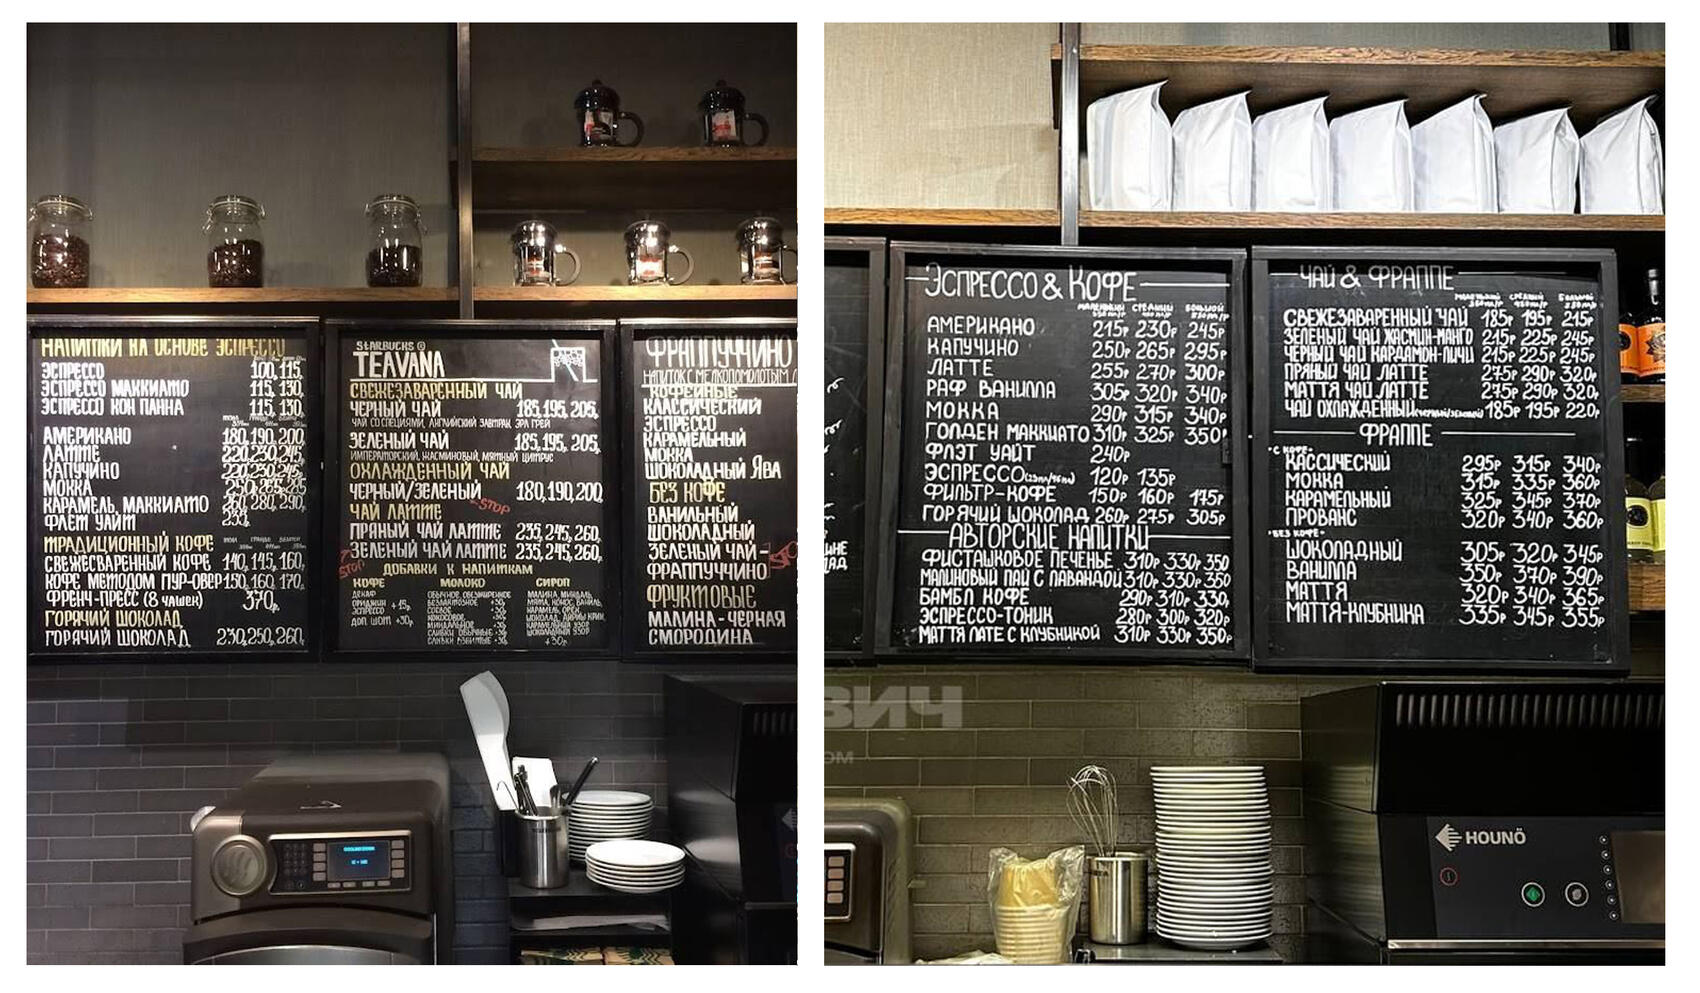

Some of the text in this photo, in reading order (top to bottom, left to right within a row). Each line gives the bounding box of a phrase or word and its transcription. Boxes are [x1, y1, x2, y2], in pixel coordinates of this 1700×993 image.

[1069, 265, 1137, 301] КОФЕ
[927, 316, 1035, 336] АМЕРИКАНО
[1284, 305, 1468, 328] СВЕЖЕЗАВАРЕННЫЙ ЧАЙ
[1284, 326, 1346, 346] ЗЕЛЕНЫЙ
[1353, 326, 1379, 346] ЧАЙ
[928, 338, 1019, 356] КАПУЧИНО
[1340, 344, 1367, 363] ЧАЙ
[41, 362, 104, 380] ЭСПРЕССО
[353, 351, 445, 378] TEAVANA
[927, 359, 994, 377] ЛАТТЕ
[1285, 362, 1428, 381] ПРЯНЫЙ ЧАЙ ЛАТТЕ
[41, 380, 106, 397] ЭСПРЕССО
[350, 380, 523, 400] СВЕЖЕЗАВАРЕННЫЙ ЧАЙ
[926, 380, 967, 398] РАФ
[1284, 381, 1428, 400] МАТТЯ ЧАЙ ЛАТТЕ
[41, 398, 184, 415] ЭСПРЕССО КОН ПАННА
[412, 396, 441, 418] ЧАЙ
[643, 397, 762, 415] КЛАССИЧЕСКИЙ
[926, 401, 1000, 420] МОККА
[1285, 398, 1311, 418] ЧАЙ
[643, 416, 716, 432] ЭСПРЕССО
[925, 423, 1089, 443] ГОЛДЕН МАККИАТО
[43, 426, 131, 445] АМЕРИКАНО
[349, 429, 449, 449] ЗЕЛЕНЫЙ ЧАЙ
[643, 428, 746, 447] КАРАМЕЛЬНЫЙ
[1360, 423, 1433, 447] ФРАППЕ
[644, 448, 694, 462] МОККА
[925, 443, 1035, 462] ФЛЭТ УАЙТ
[43, 462, 120, 480] КАПУЧИНО
[480, 460, 511, 480] ЧАЙ
[43, 480, 92, 496] МОККА
[1286, 471, 1344, 490] МОККА
[650, 480, 725, 503] БЕЗ КОФЕ
[923, 484, 1056, 502] ФИЛЬТР-КОФЕ
[1286, 485, 1391, 508] КАРАМЕЛЬНЫЙ
[350, 501, 381, 520] ЧАЙ
[648, 502, 738, 523] ВАНИЛЬНЫЙ
[922, 504, 1090, 524] ГОРЯЧИЙ ШОКОЛАД
[1286, 508, 1357, 526] ПРОВАНС
[350, 520, 412, 540] ПРЯНЫЙ
[417, 520, 443, 540] ЧАЙ
[648, 520, 755, 544] ШОКОЛАДНЫЙ
[949, 523, 1149, 550] АВТОРСКИЕ НАПИТКИ
[176, 535, 214, 553] КОФЕ
[649, 540, 756, 561] ЗЕЛЕНЫЙ ЧАЙ
[1286, 539, 1402, 562] ШОКОЛАДНЫЙ
[44, 551, 211, 572] СВЕЖЕСВАРЕННЫЙ КОФЕ
[922, 549, 1113, 569] ФИСТАШКОВОЕ ПЕЧЕНЬЕ
[647, 560, 767, 581] ФРАППУЧЧИНО
[920, 567, 998, 587] МАЛИНОВЫЙ
[1034, 570, 1044, 587] С
[1287, 561, 1357, 581] ВАНИЛЛА
[353, 578, 570, 588] КОФЕ МОЛОКО СИРОП
[1286, 581, 1348, 601] МАТТЯ
[920, 588, 1029, 605] БАМБЛ КОФЕ
[45, 607, 109, 628] ГОРЯЧИЙ
[648, 610, 786, 628] МАЛИНА ЧЕРНАЯ
[920, 606, 1054, 625] ЭСПРЕССО-ТОНИК
[1287, 601, 1425, 624] МАТТЯ-КЛУБНИКА
[45, 627, 111, 647] ГОРЯЧИЙ
[648, 628, 753, 646] СМОРОДИНА
[919, 623, 1100, 644] МАТТЯ ЛАТЕ С КЛУБНИКОЙ
[1466, 828, 1526, 845] HOUNÖ
